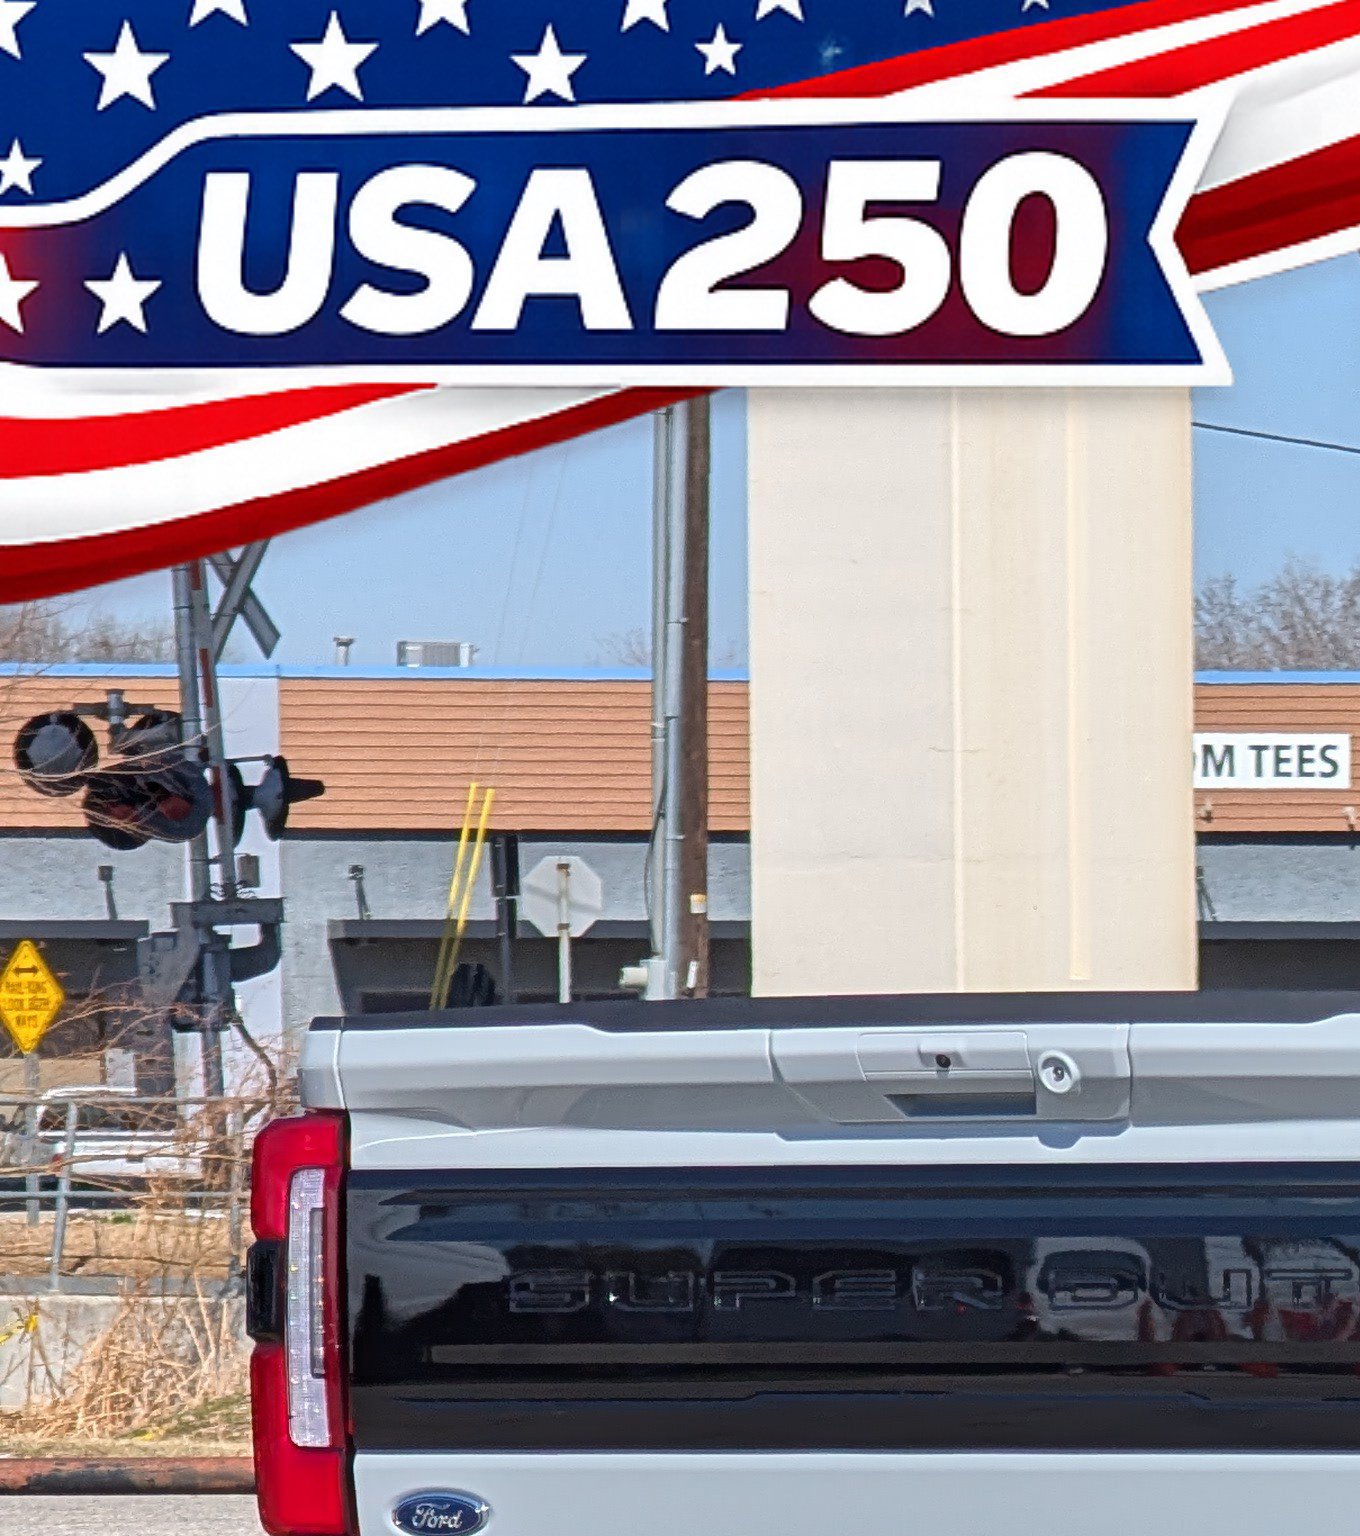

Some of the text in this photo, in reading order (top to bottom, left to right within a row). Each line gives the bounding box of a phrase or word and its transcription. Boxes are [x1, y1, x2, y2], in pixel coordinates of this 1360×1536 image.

[1194, 744, 1339, 779] M TEES
[508, 1267, 1004, 1314] SUPER
[411, 1502, 463, 1529] Ford
